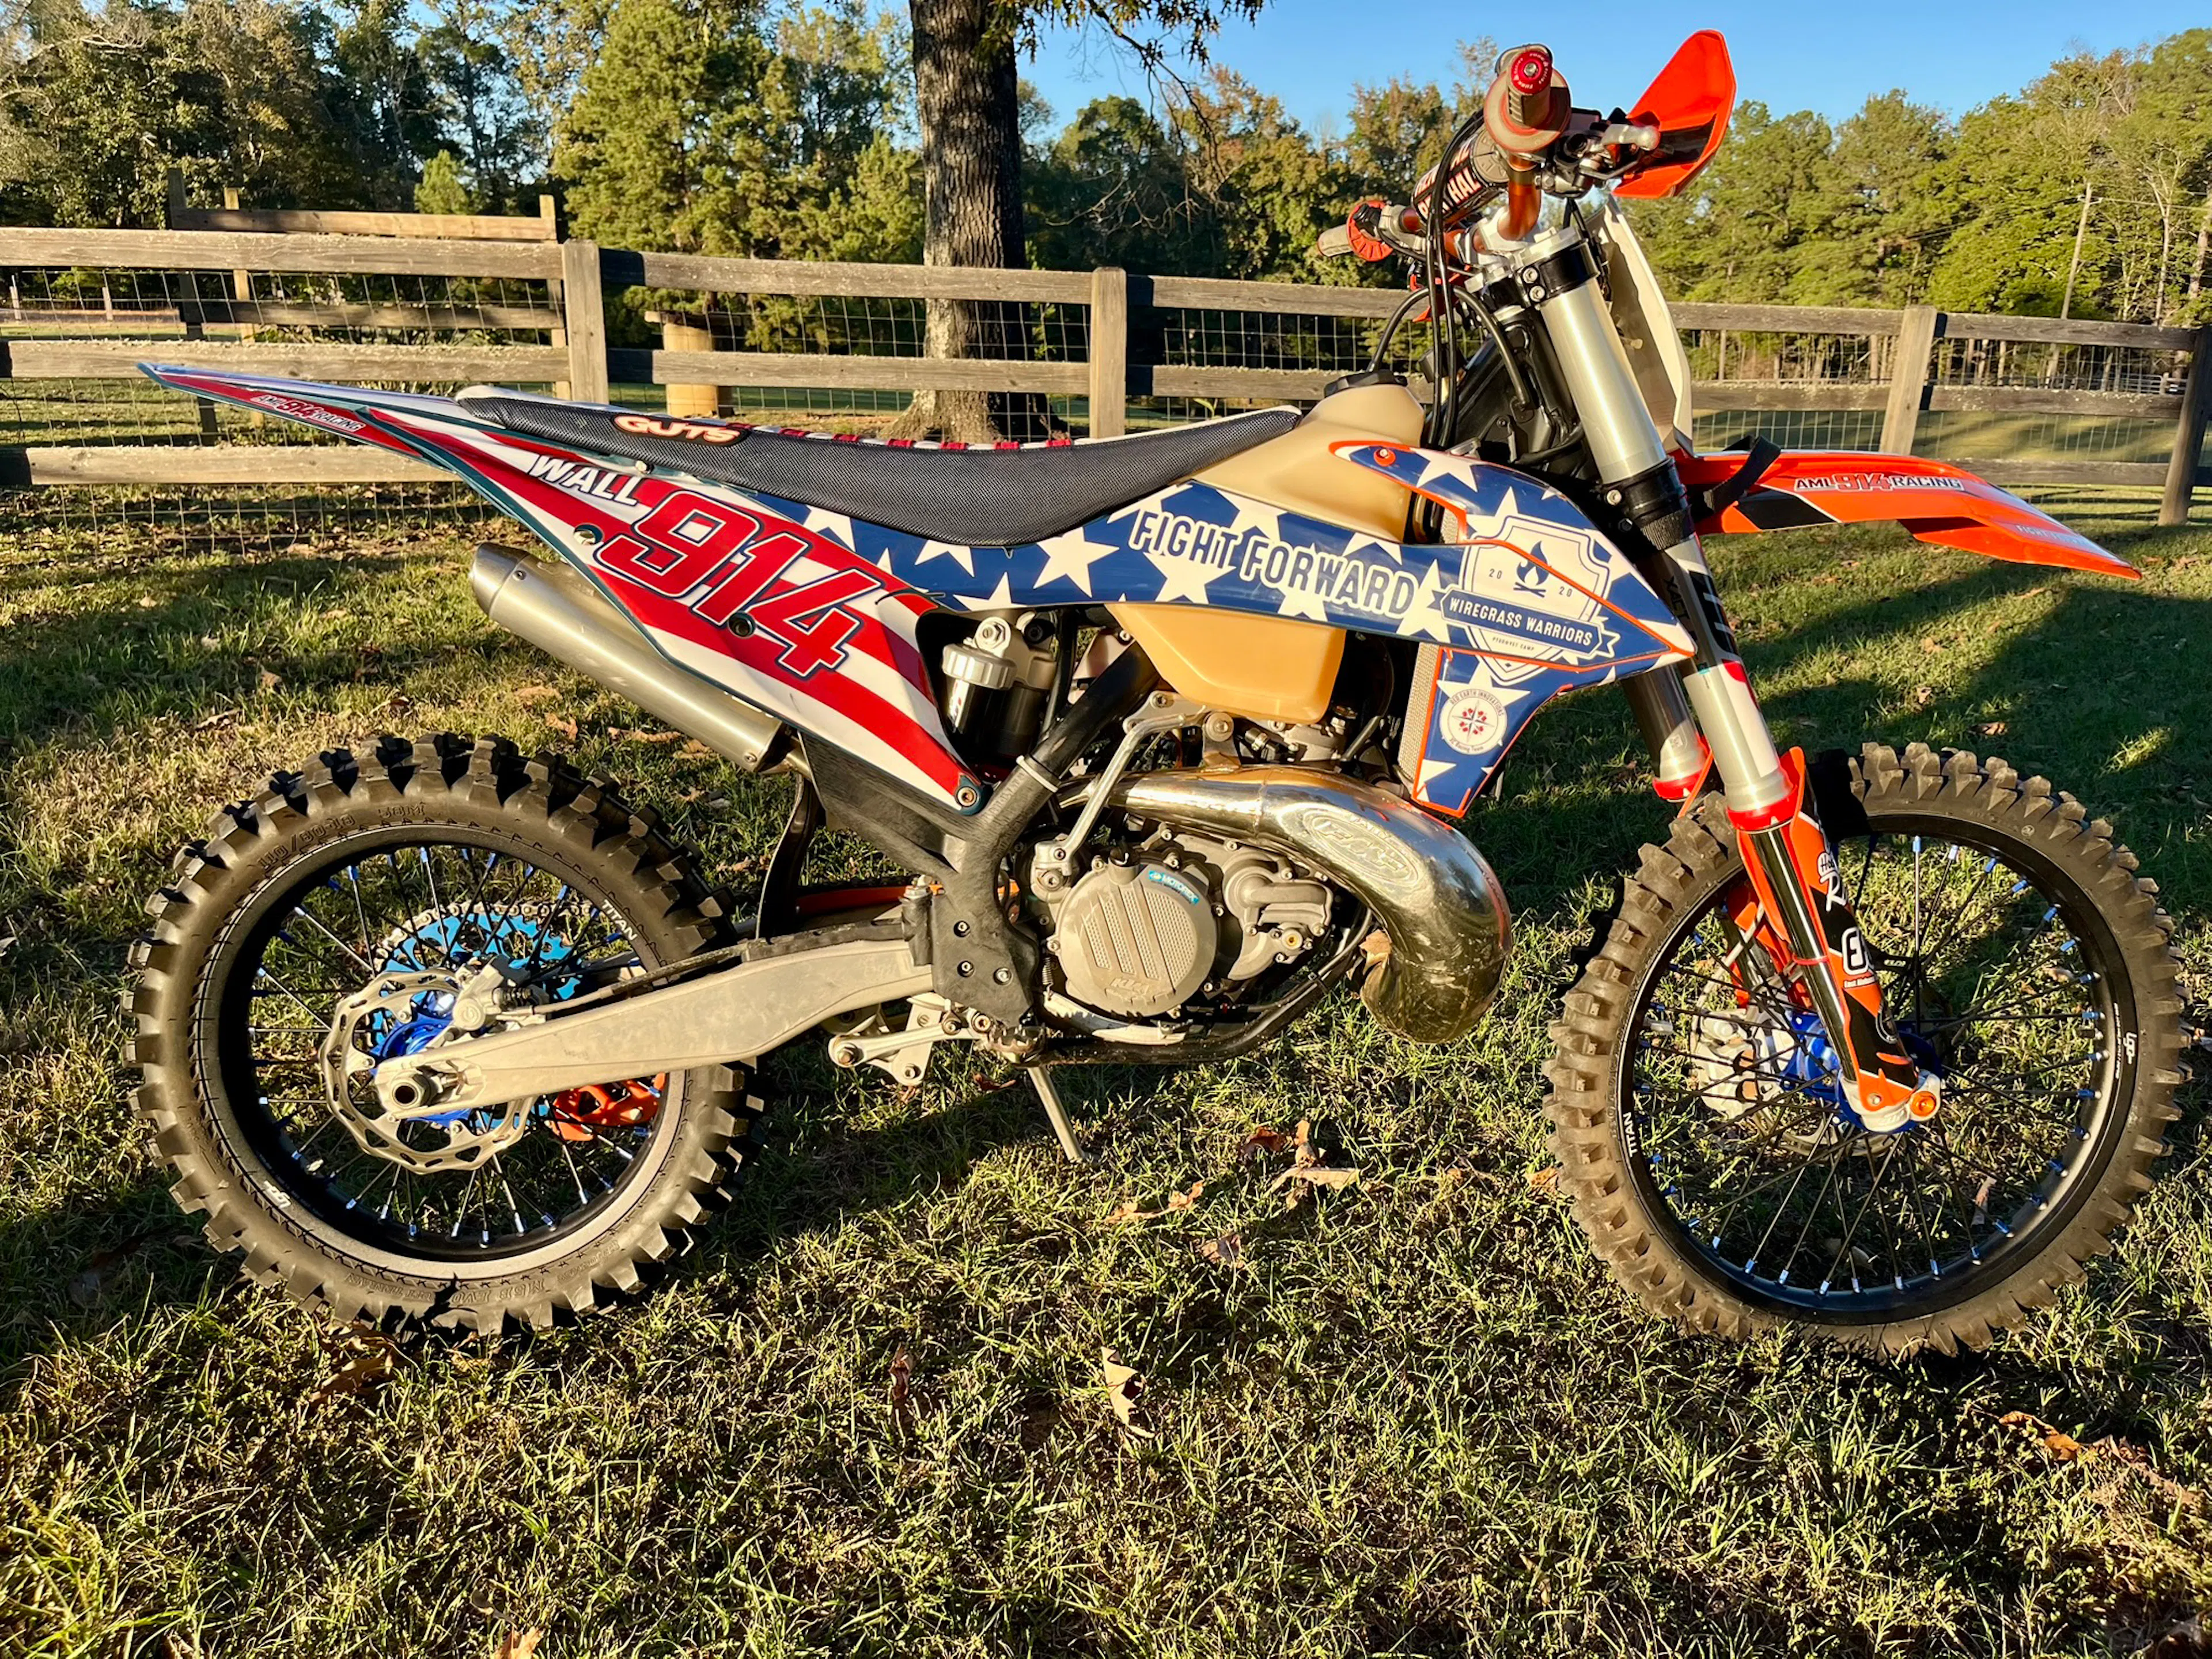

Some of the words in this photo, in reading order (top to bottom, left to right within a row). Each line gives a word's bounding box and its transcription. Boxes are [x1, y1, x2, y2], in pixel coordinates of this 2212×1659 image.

[314, 411, 365, 432] RACING
[614, 414, 740, 443] GUTS
[527, 454, 639, 506] WALL
[1832, 473, 1893, 491] 914
[1892, 477, 1964, 490] RACING
[594, 490, 885, 680] 914
[1128, 511, 1242, 569] FIGHT
[1240, 535, 1419, 619] FORWARD
[1489, 568, 1503, 579] 20
[1559, 586, 1573, 597] 20
[1449, 597, 1522, 628] WIREGRASS
[1526, 616, 1593, 646] WARRIORS
[602, 899, 638, 940] TITAN
[1623, 1111, 1638, 1158] TITAN
